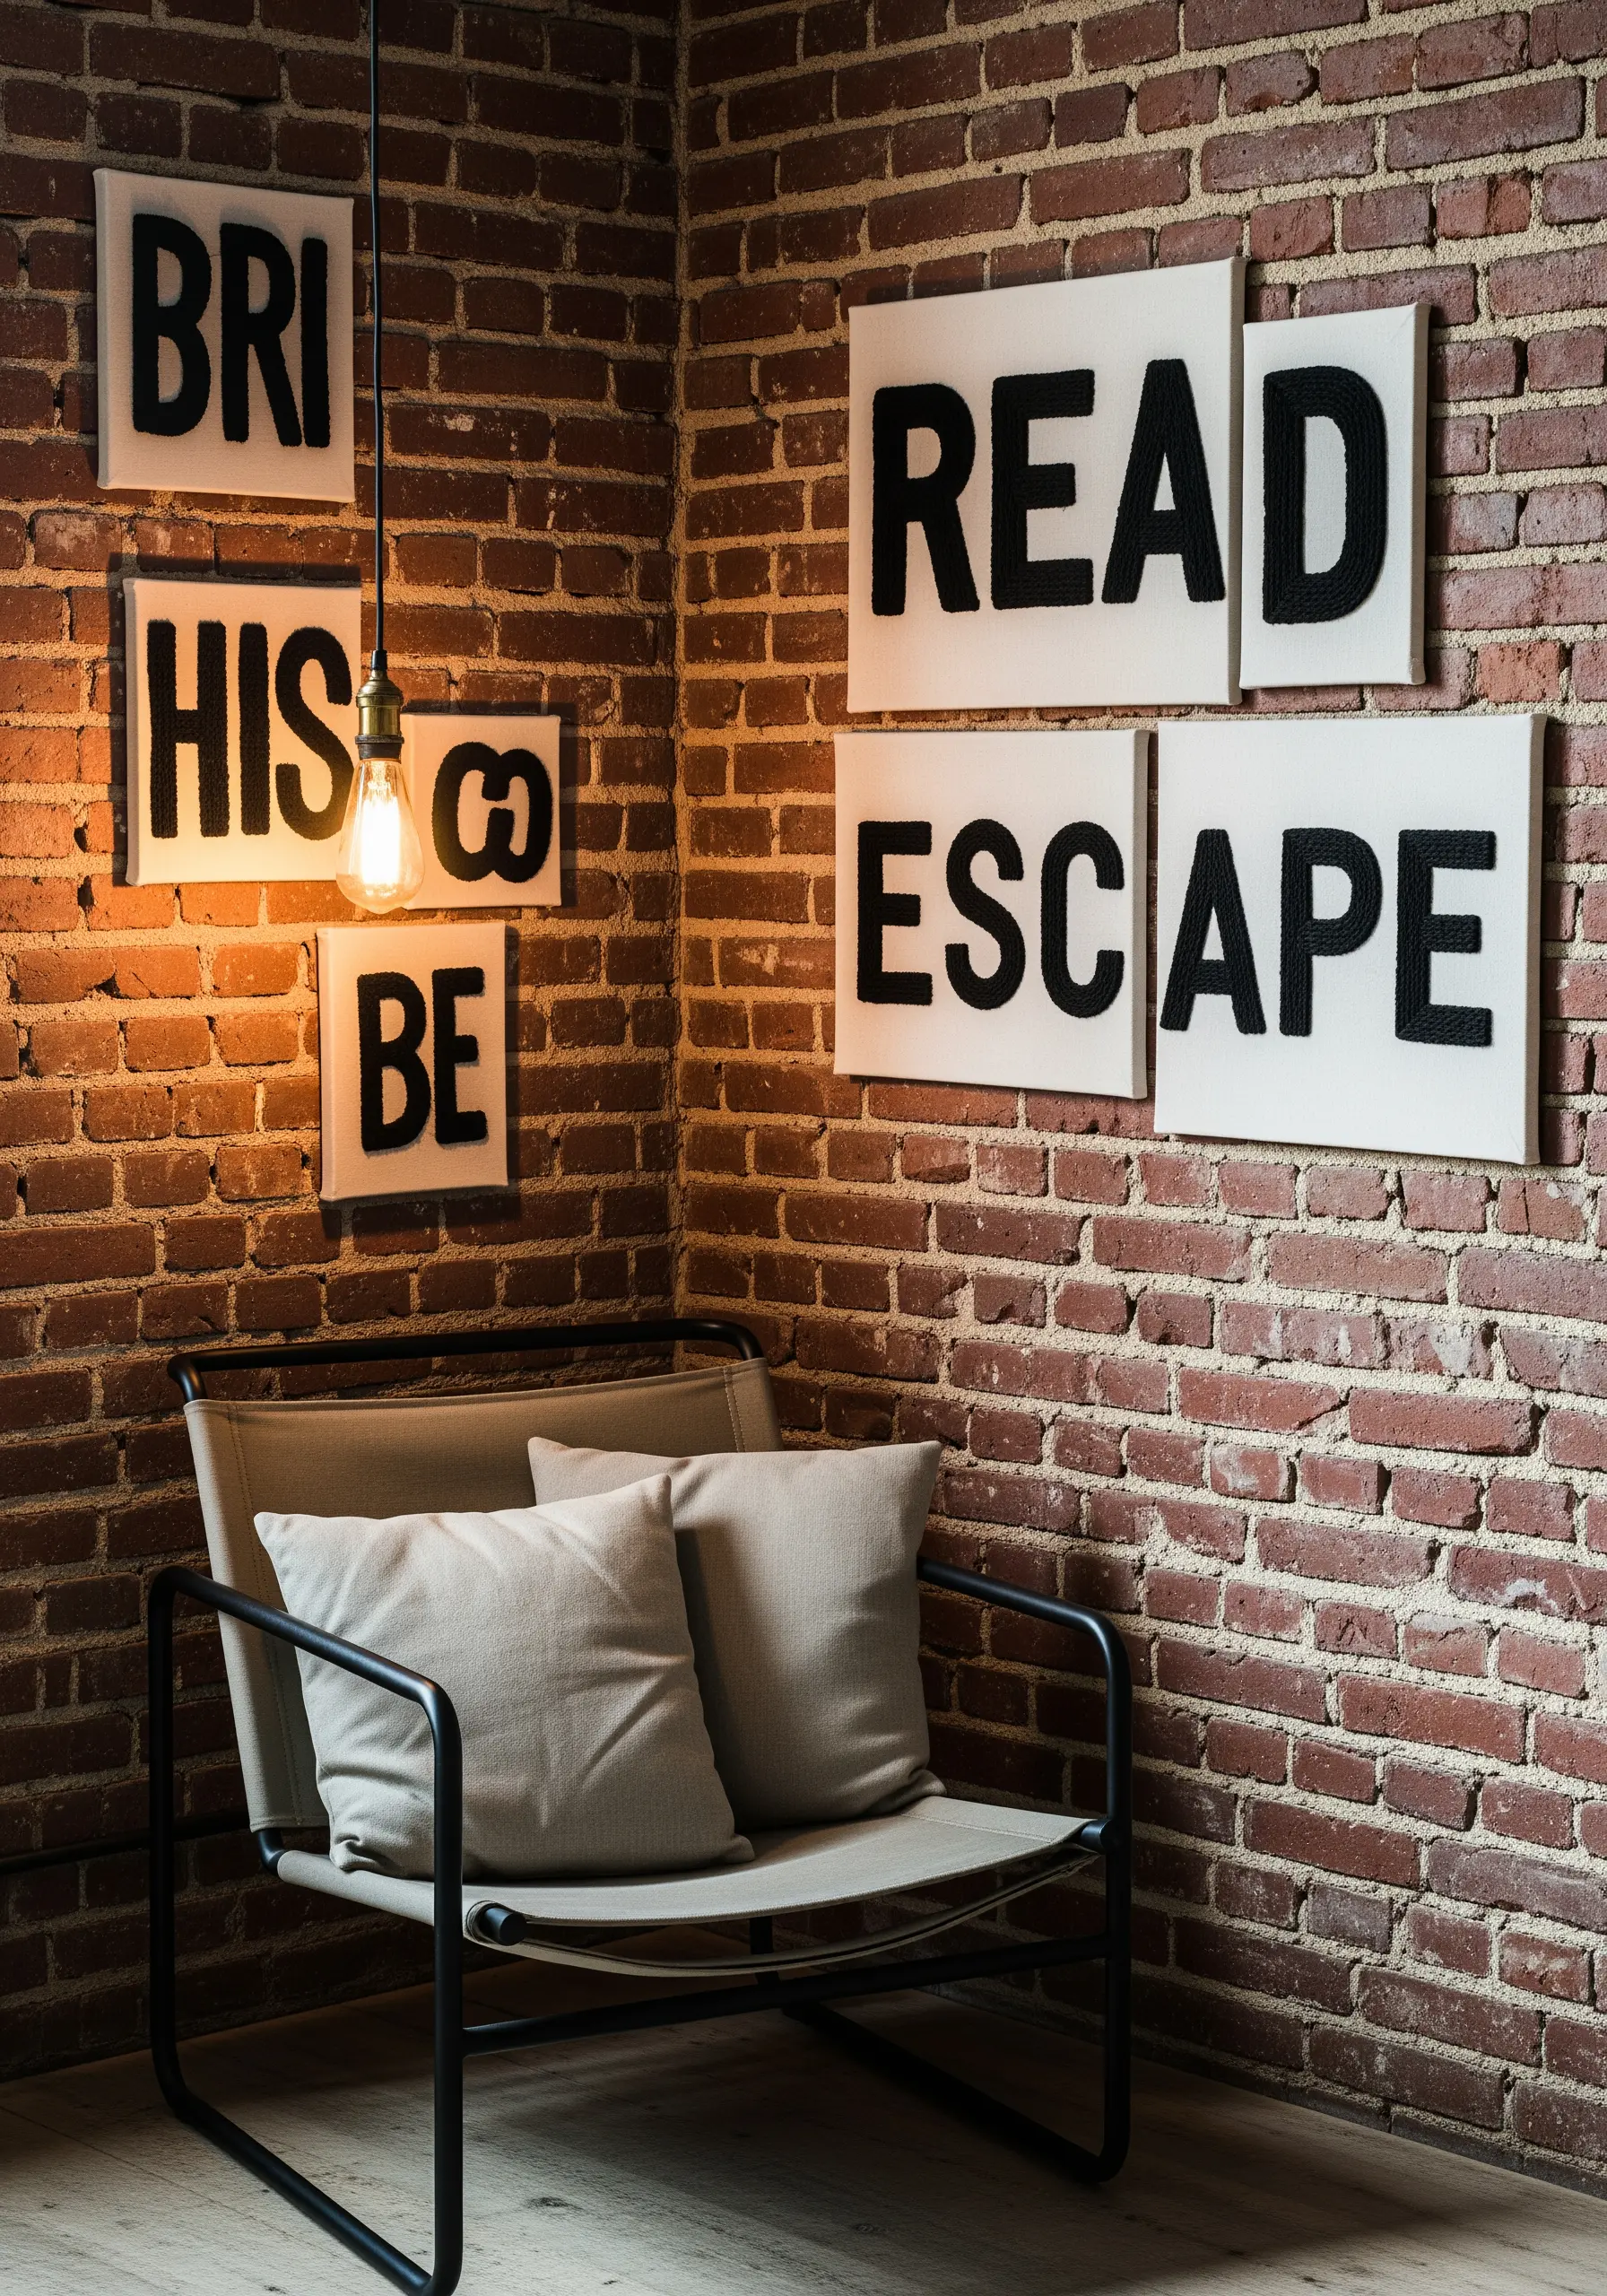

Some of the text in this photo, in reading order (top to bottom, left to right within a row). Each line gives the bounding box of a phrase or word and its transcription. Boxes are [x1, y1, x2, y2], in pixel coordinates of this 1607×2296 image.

[131, 211, 332, 449] BRI
[146, 618, 355, 841] HIS
[356, 966, 490, 1155] BE
